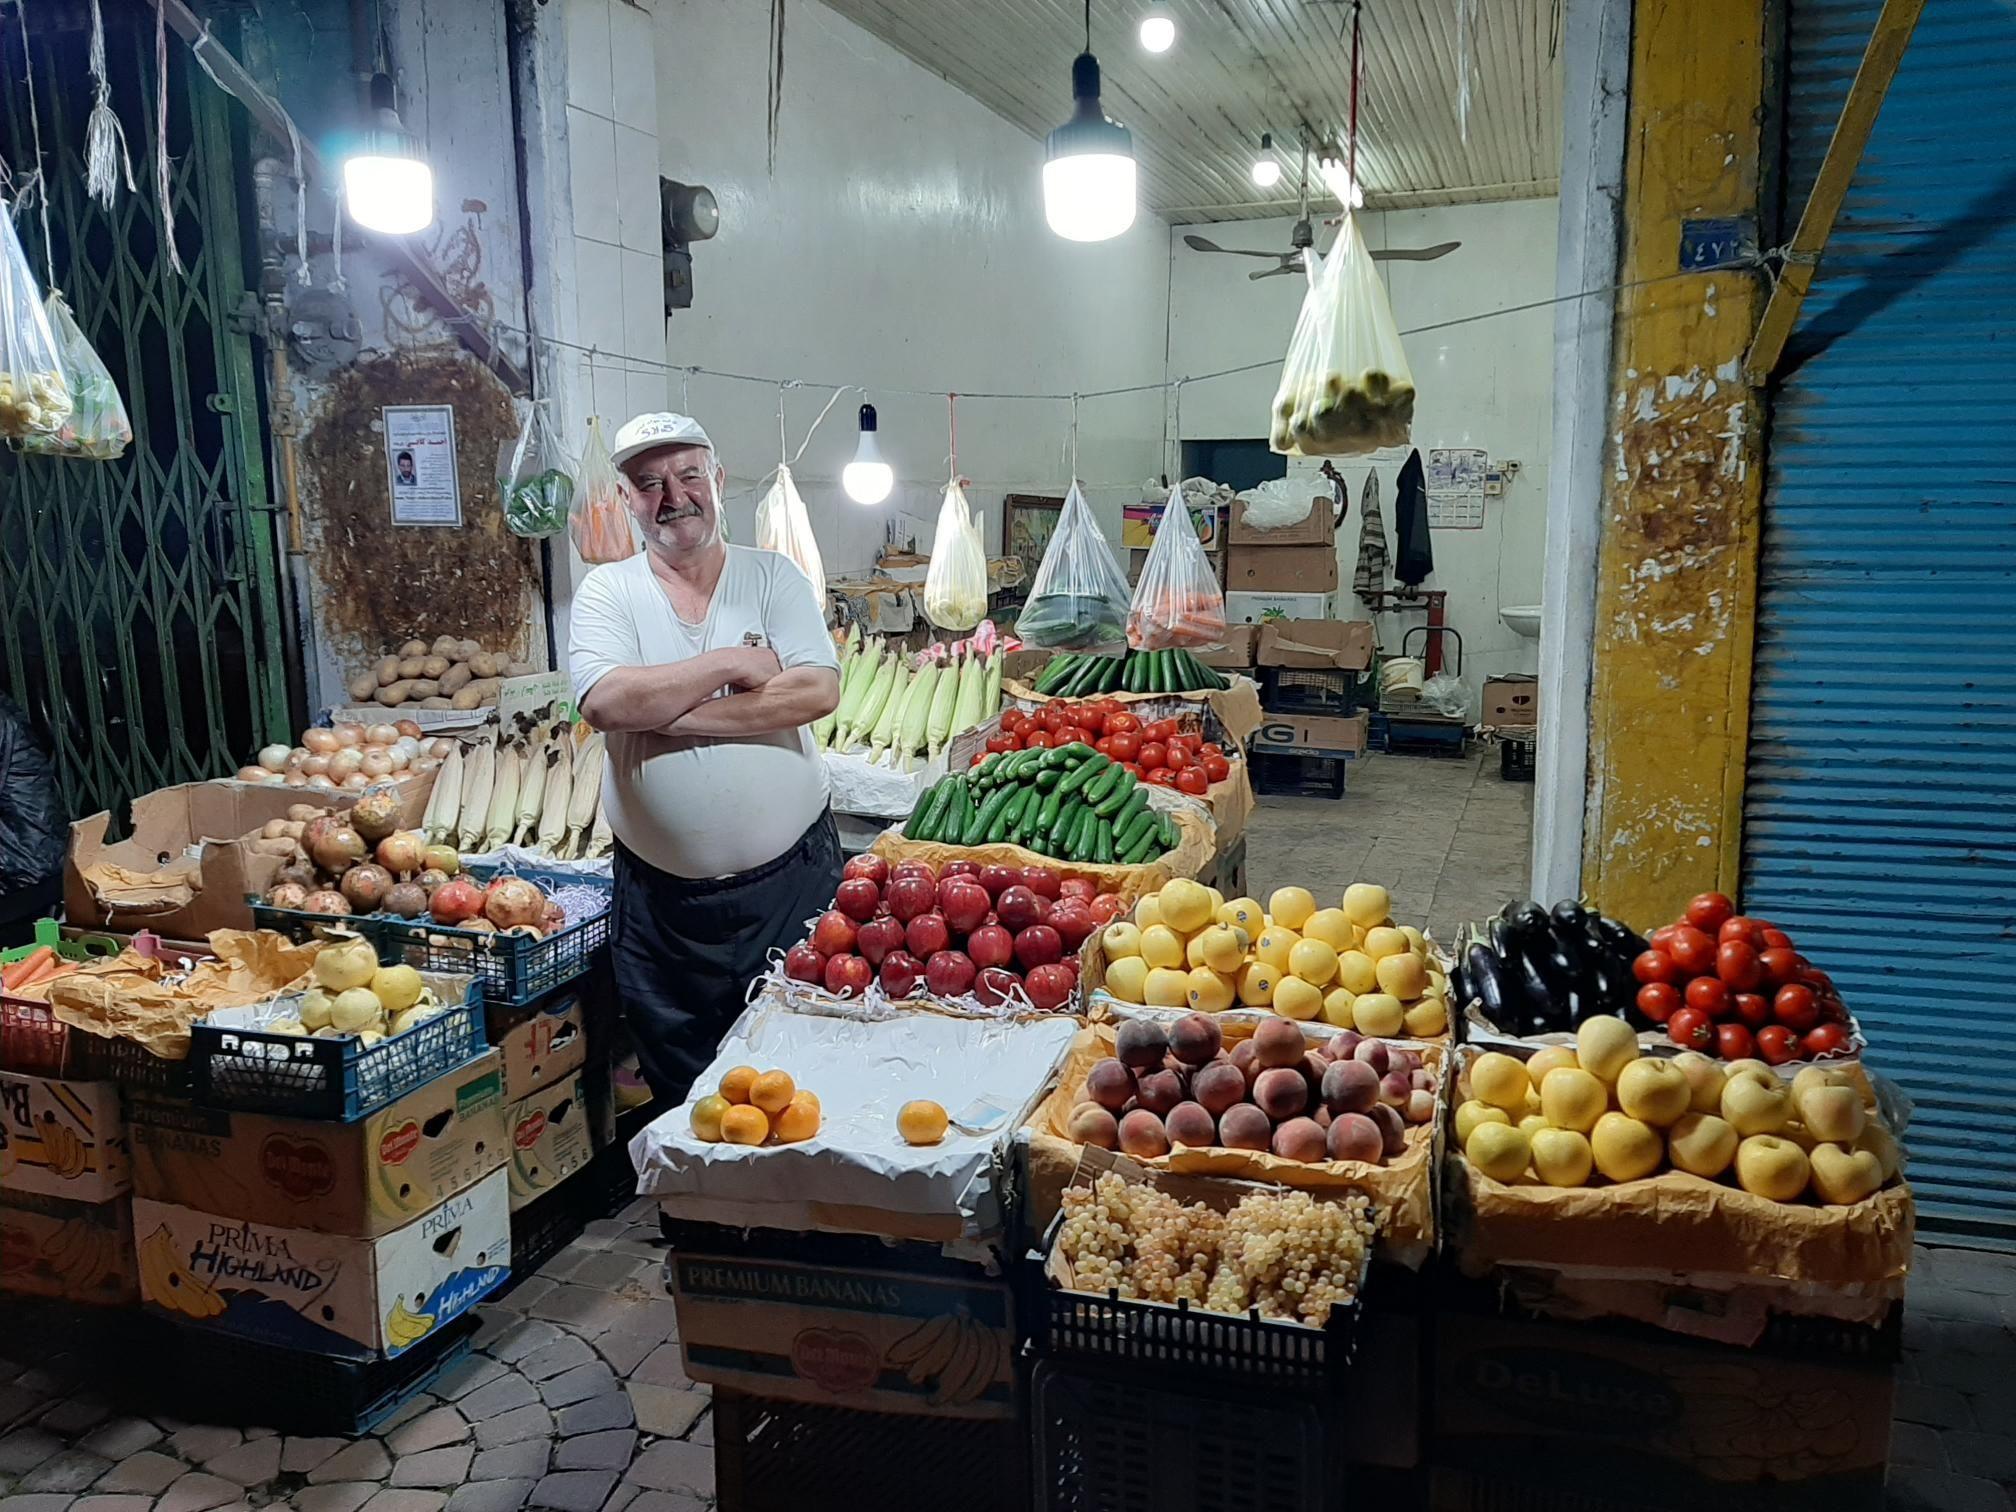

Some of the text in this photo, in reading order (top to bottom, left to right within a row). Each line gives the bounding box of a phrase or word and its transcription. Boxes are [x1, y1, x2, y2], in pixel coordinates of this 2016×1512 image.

[134, 1127, 221, 1158] BANANAS
[421, 1197, 474, 1239] PRIMA
[208, 1222, 296, 1260] PRIMA
[189, 1239, 322, 1291] HIGHLAND
[438, 1266, 501, 1321] HIGHLAND
[687, 1265, 901, 1308] PREMIUM BANANAS
